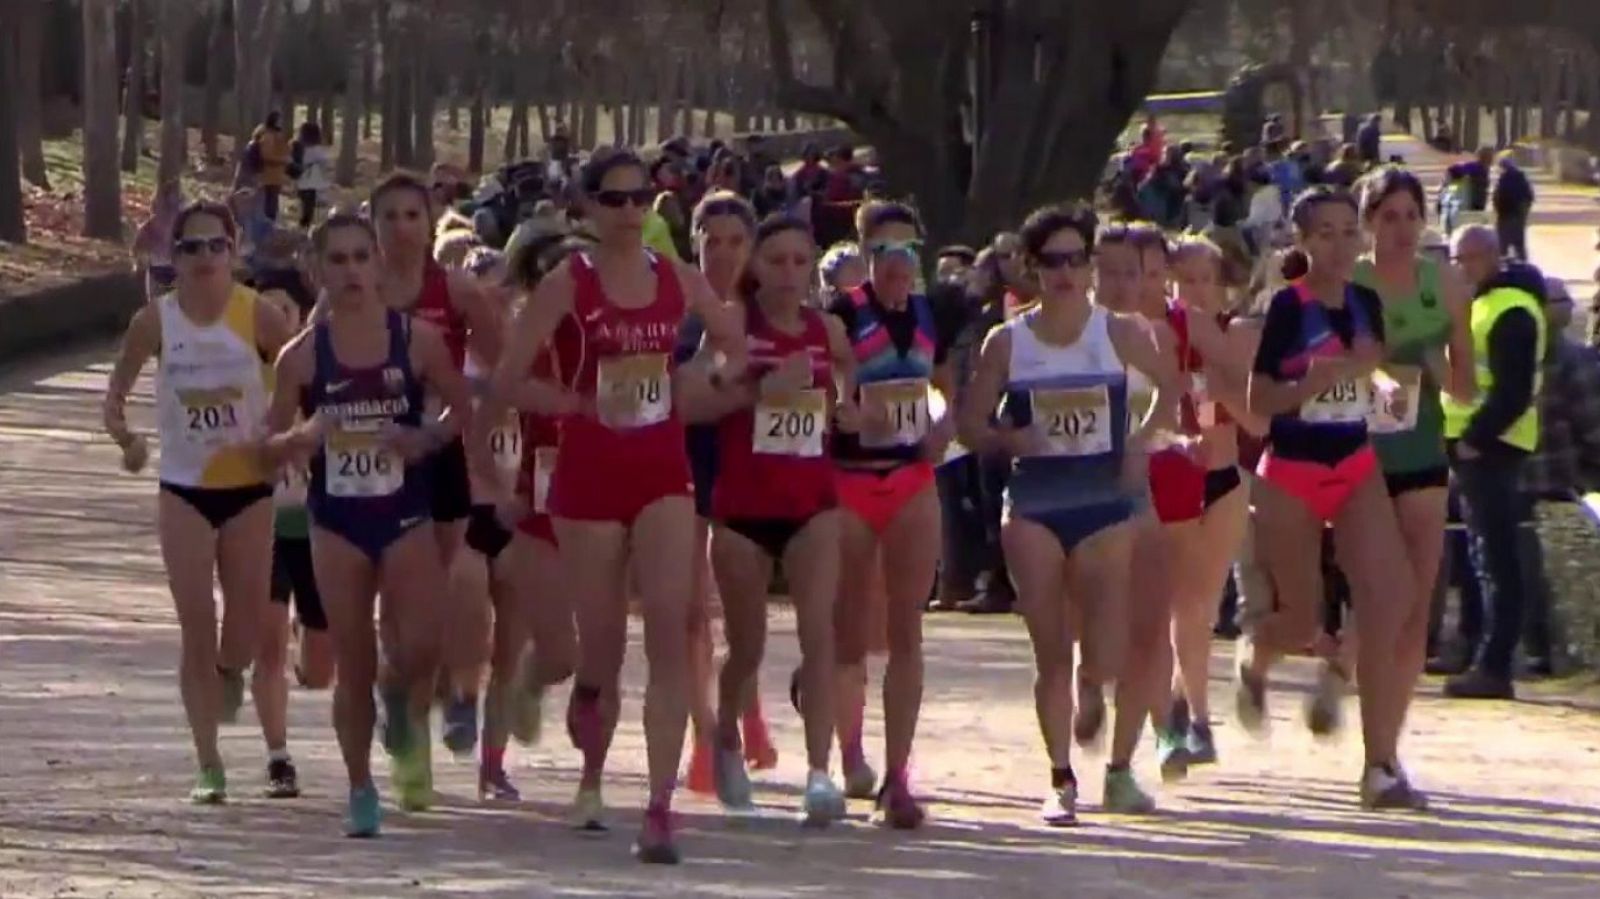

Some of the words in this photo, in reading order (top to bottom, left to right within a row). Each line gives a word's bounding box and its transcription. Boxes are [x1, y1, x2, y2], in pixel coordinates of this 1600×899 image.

[187, 402, 238, 431] 203
[768, 411, 815, 438] 200
[1048, 411, 1097, 438] 202
[491, 430, 518, 455] 01
[338, 451, 391, 477] 206
